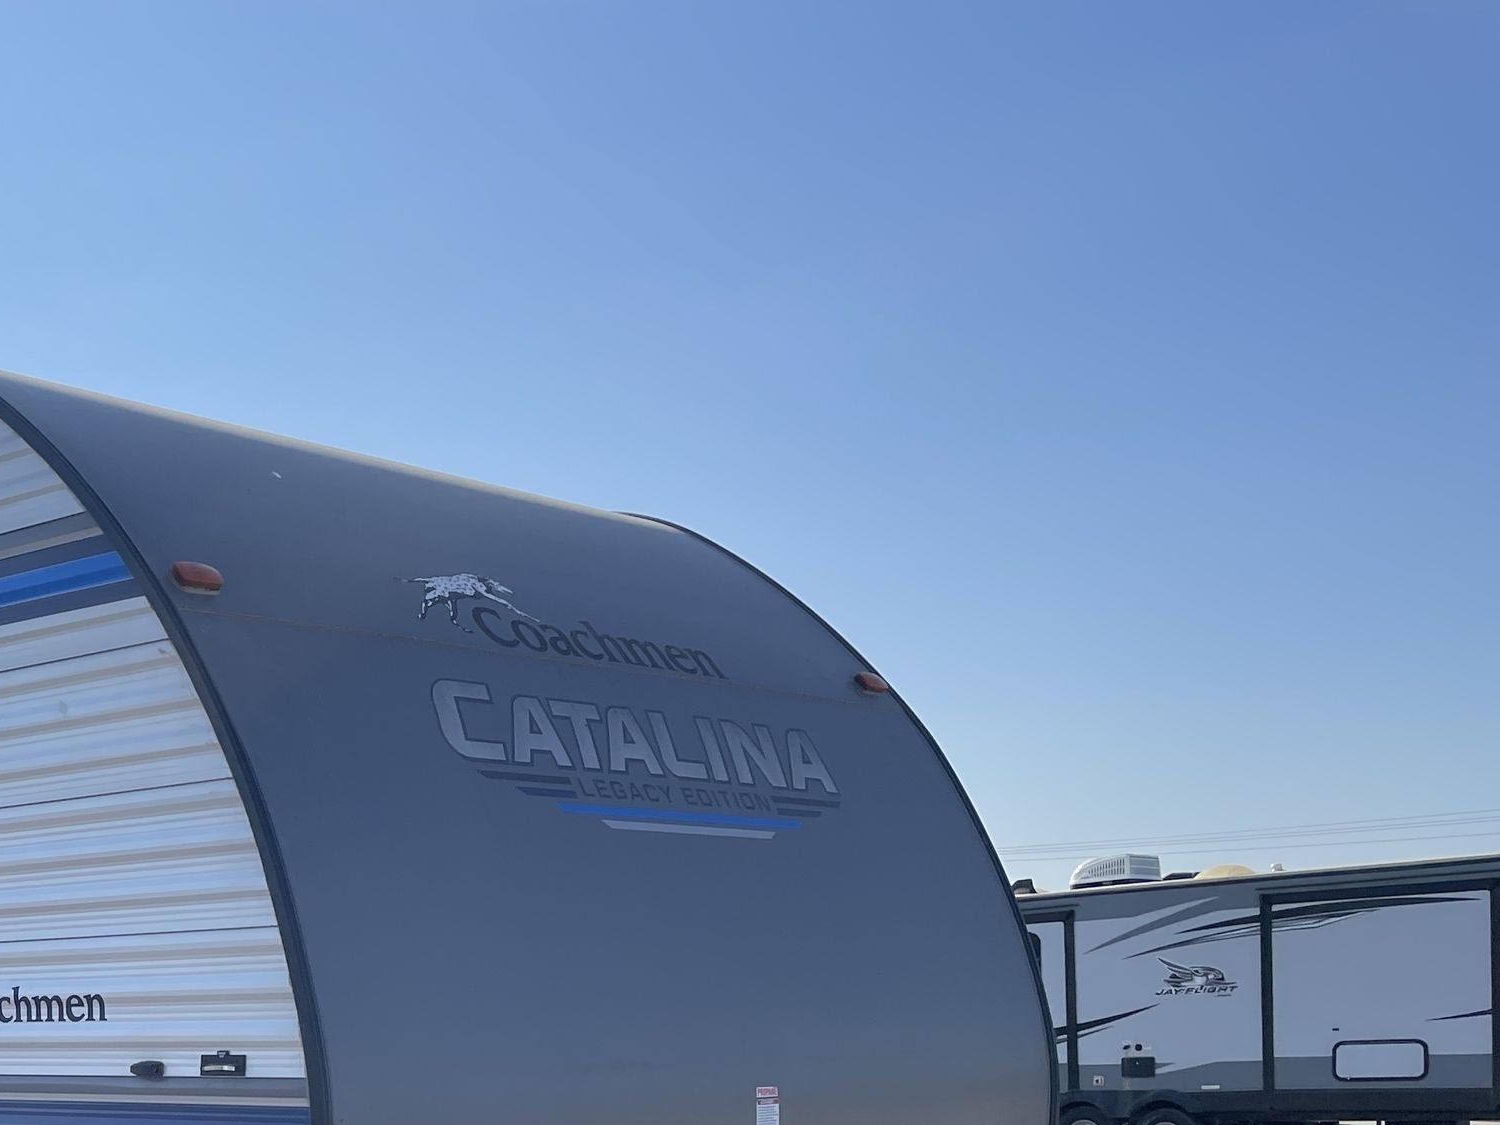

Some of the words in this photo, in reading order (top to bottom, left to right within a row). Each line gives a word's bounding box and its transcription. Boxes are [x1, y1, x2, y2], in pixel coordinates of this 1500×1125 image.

[472, 606, 726, 679] Coachmen
[431, 678, 840, 794] CATALINA
[576, 777, 672, 804] LEGACY
[680, 787, 772, 812] EDITION
[1155, 987, 1184, 996] JAY
[1184, 985, 1238, 995] FLIGHT
